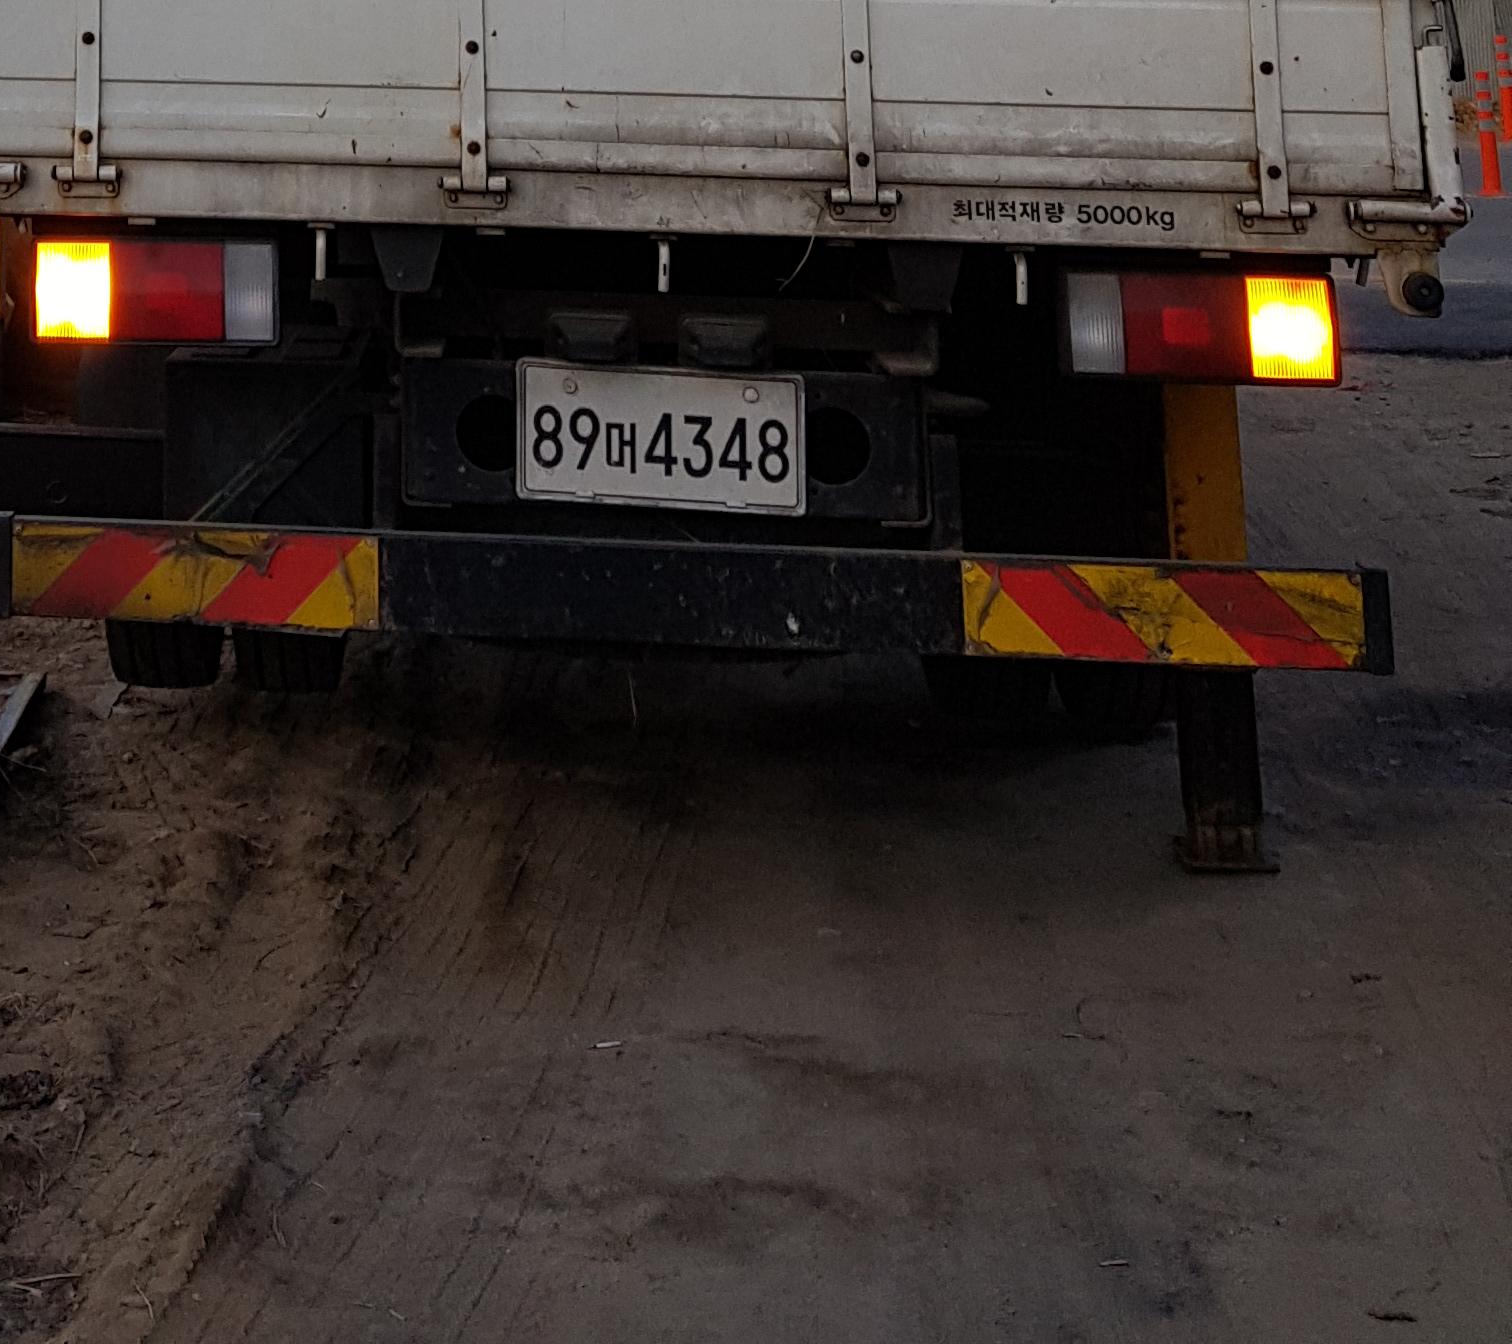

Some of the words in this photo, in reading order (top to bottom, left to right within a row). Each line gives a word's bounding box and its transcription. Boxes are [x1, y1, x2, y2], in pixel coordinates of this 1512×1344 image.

[952, 199, 1065, 224] 최대적재량
[1076, 204, 1176, 232] 5000kg
[533, 405, 789, 483] 89머4348
